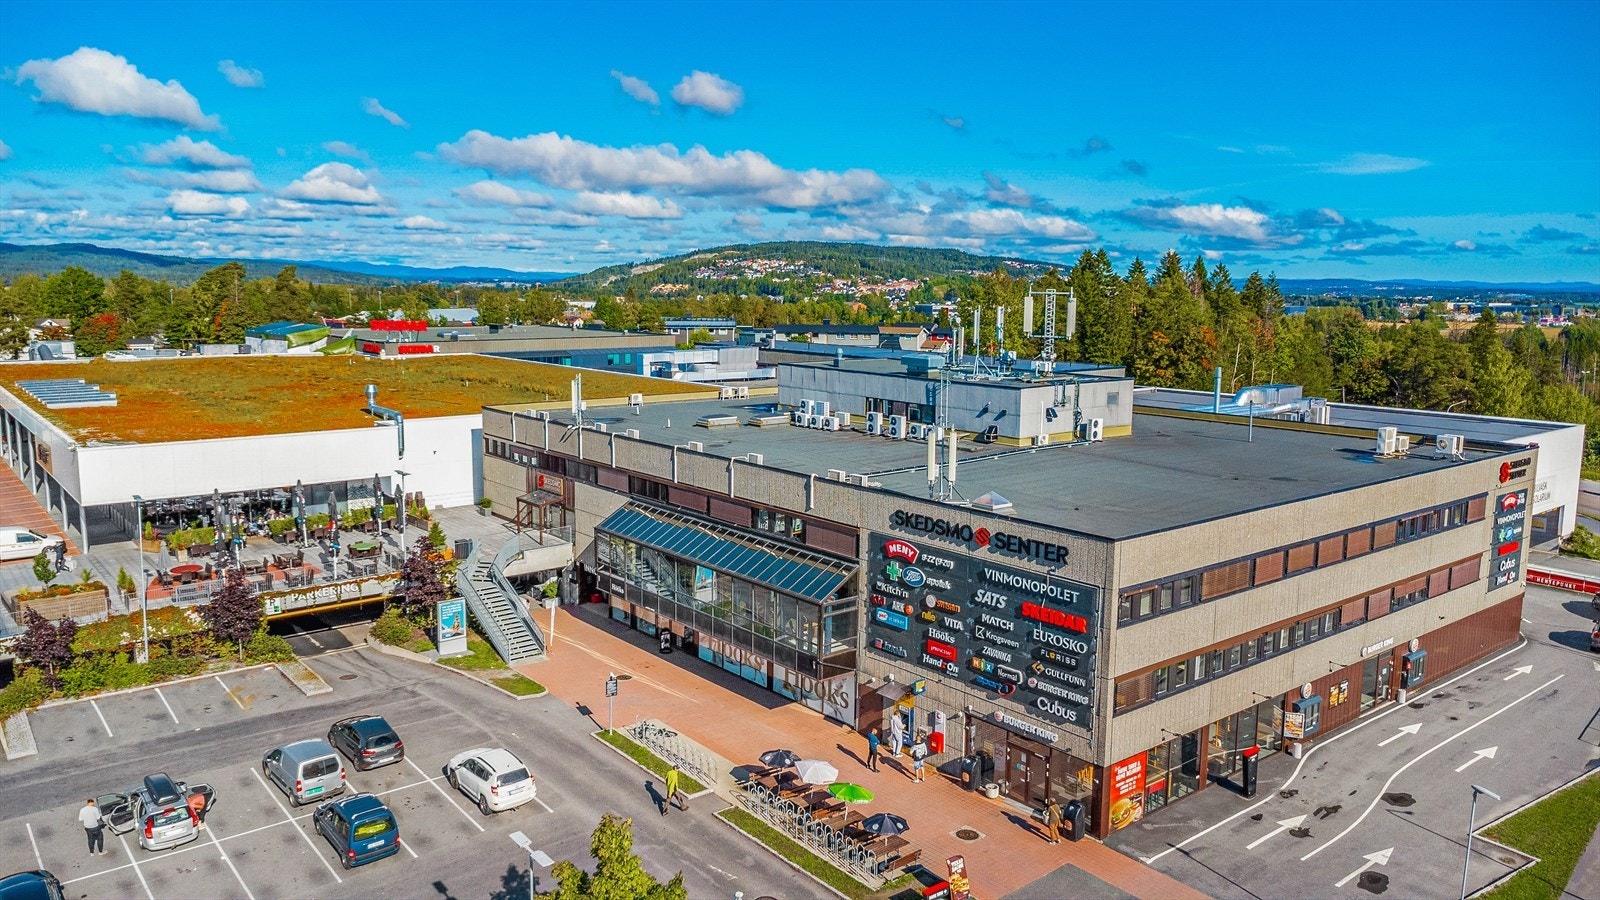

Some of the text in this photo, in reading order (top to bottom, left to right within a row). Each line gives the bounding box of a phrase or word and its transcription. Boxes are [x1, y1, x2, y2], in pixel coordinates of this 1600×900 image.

[894, 509, 974, 543] SKEDSMO
[994, 532, 1069, 565] SENTER
[888, 544, 915, 558] MENY
[291, 583, 359, 602] PARKERING
[984, 568, 1080, 603] VINMONOPOLET
[974, 589, 1008, 608] SATS
[944, 616, 965, 631] VITA
[981, 613, 1015, 631] MATCH
[1021, 601, 1088, 634] SKEIDAR
[985, 630, 1020, 649] Krogsveen
[1033, 628, 1089, 654] EUROSKO
[982, 645, 1012, 663] ZAVANNA
[1040, 648, 1077, 666] FLORISS
[997, 668, 1018, 681] Normal
[1045, 667, 1086, 687] GULLFUNN
[1037, 681, 1089, 705] BURGER KING
[1037, 696, 1077, 721] Cubus
[1002, 713, 1059, 743] BURGER KING
